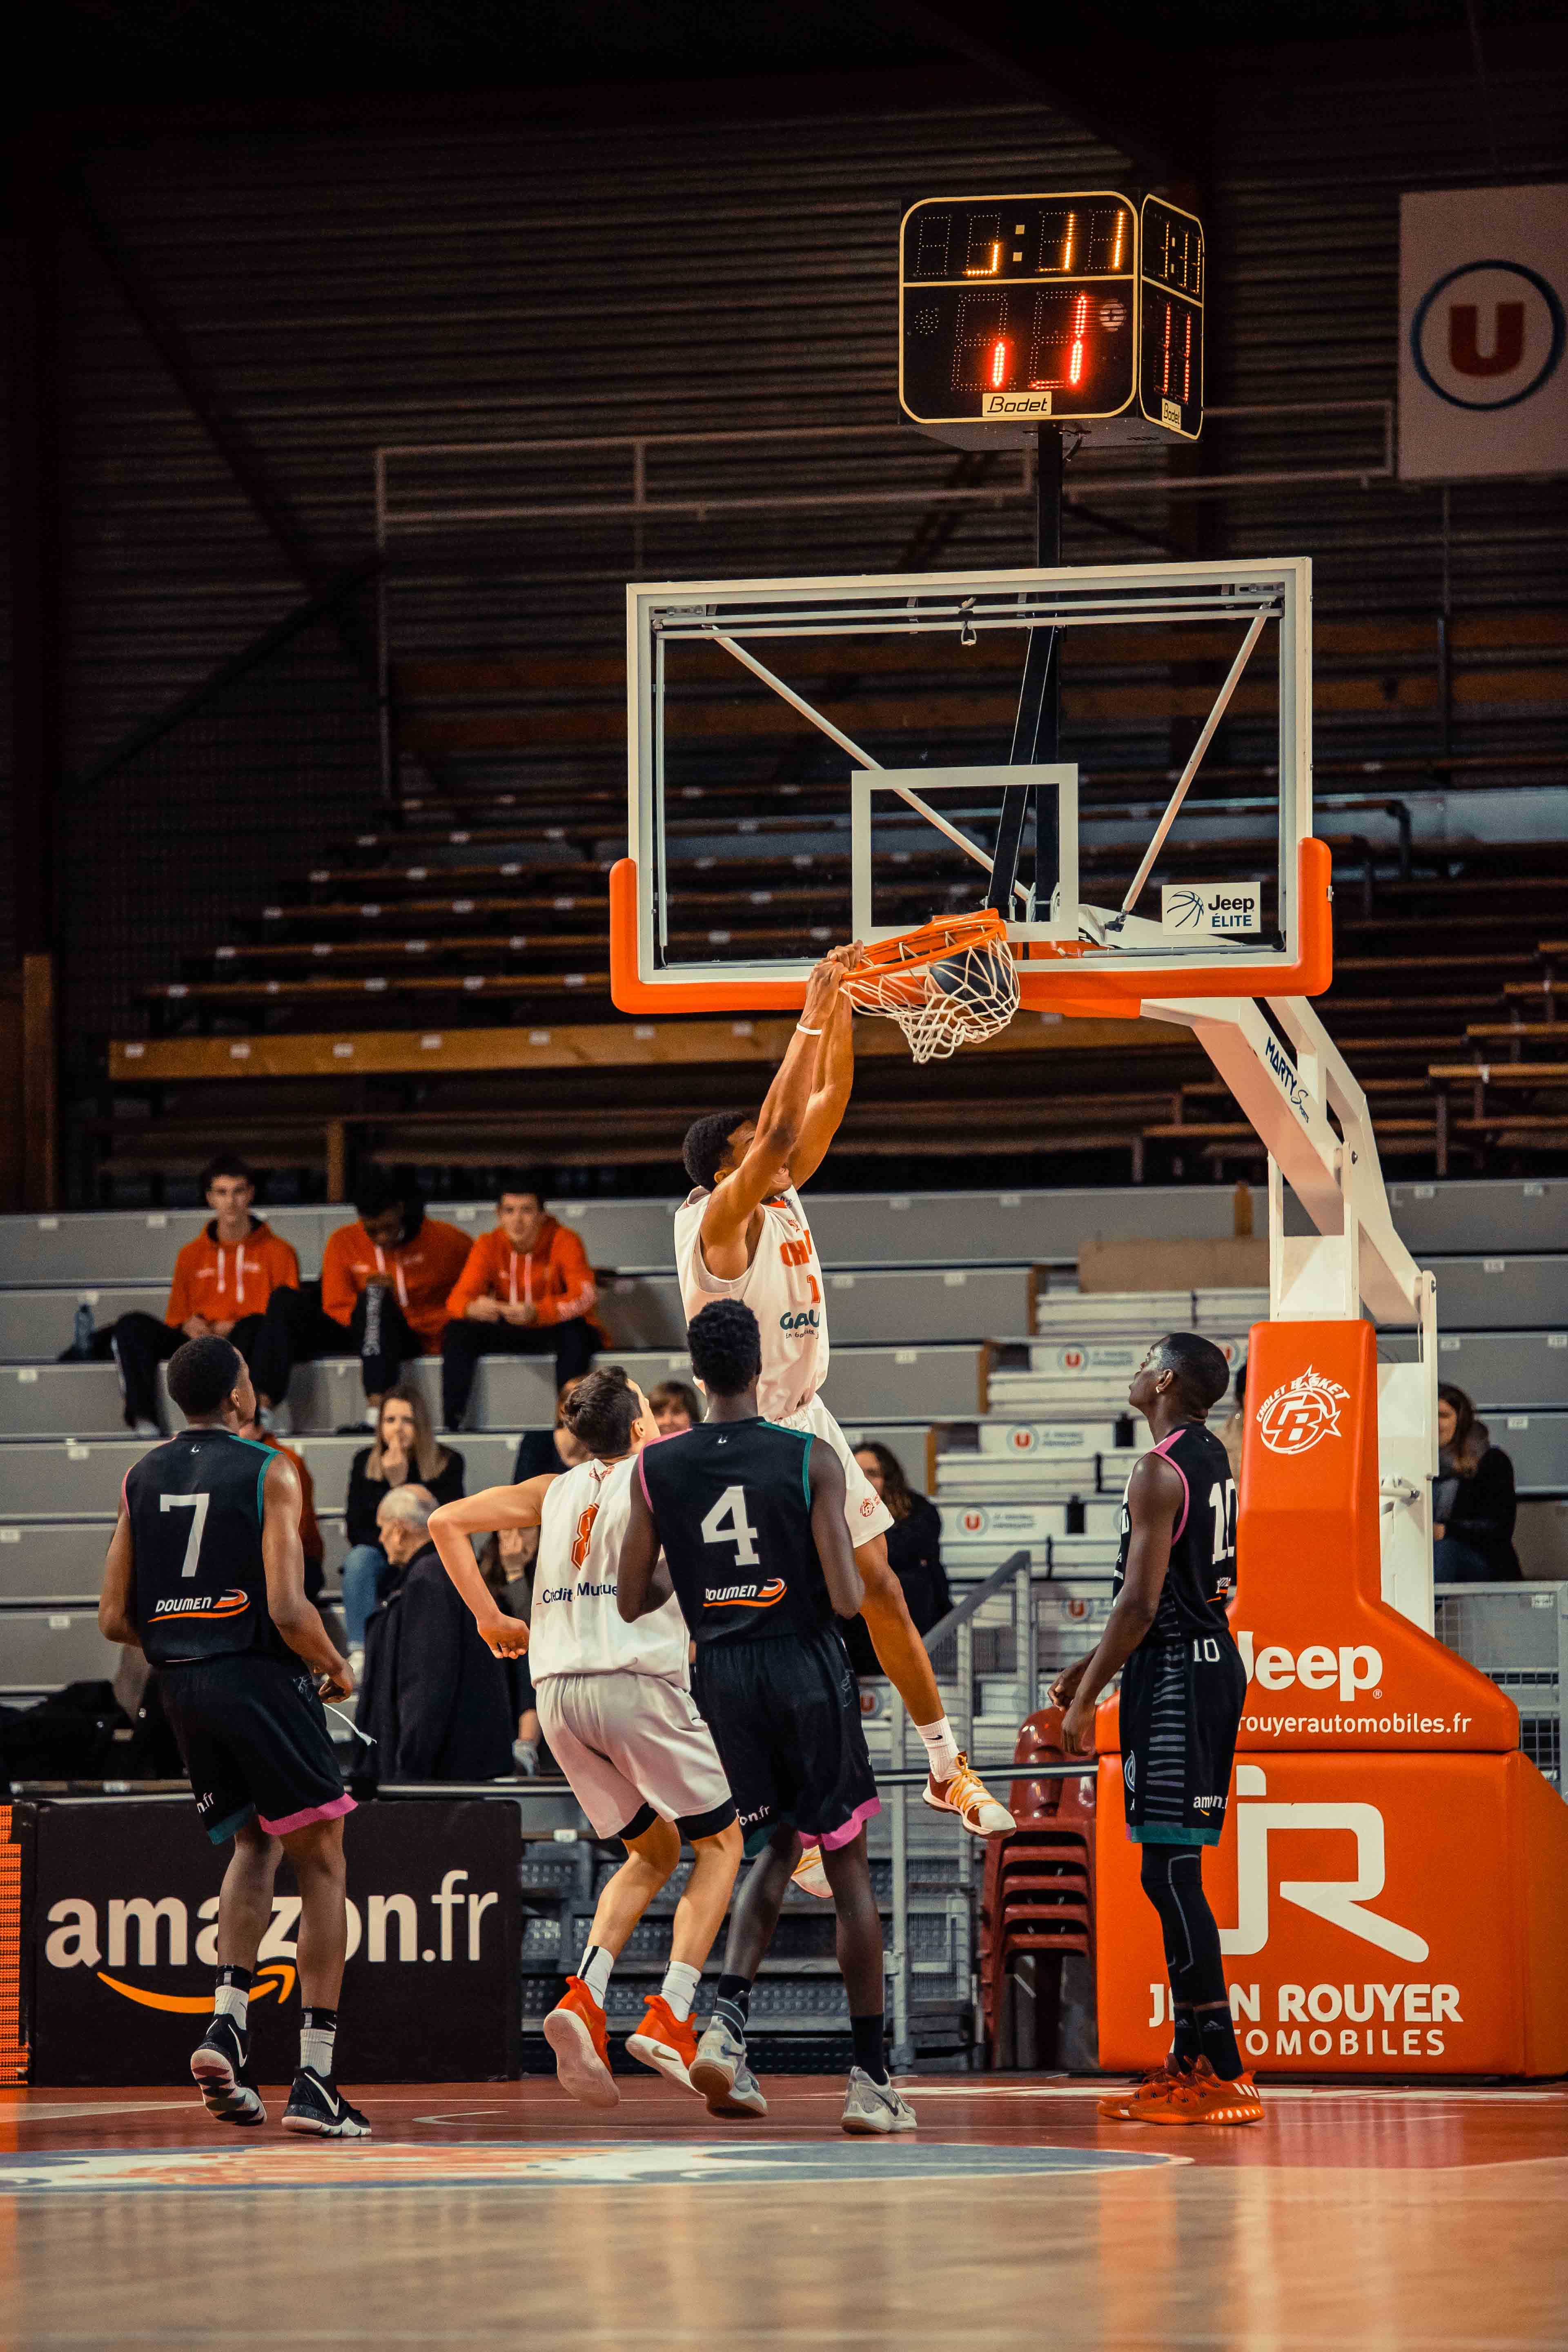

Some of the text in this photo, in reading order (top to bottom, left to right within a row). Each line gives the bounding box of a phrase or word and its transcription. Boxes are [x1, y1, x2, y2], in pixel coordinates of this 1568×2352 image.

[1450, 301, 1526, 376] U
[987, 396, 1048, 413] Bodet
[1163, 403, 1180, 425] Bodet
[1208, 894, 1255, 913] Jeep
[1212, 913, 1252, 927] ÉLITE
[160, 1493, 210, 1577] 7
[701, 1486, 760, 1566] 4
[577, 1582, 618, 1597] Mutue
[156, 1596, 212, 1613] DOUMEN
[1193, 1637, 1220, 1662] 10
[45, 1869, 499, 1968] amzn.fr
[1149, 1984, 1463, 2027] JN ROUYER
